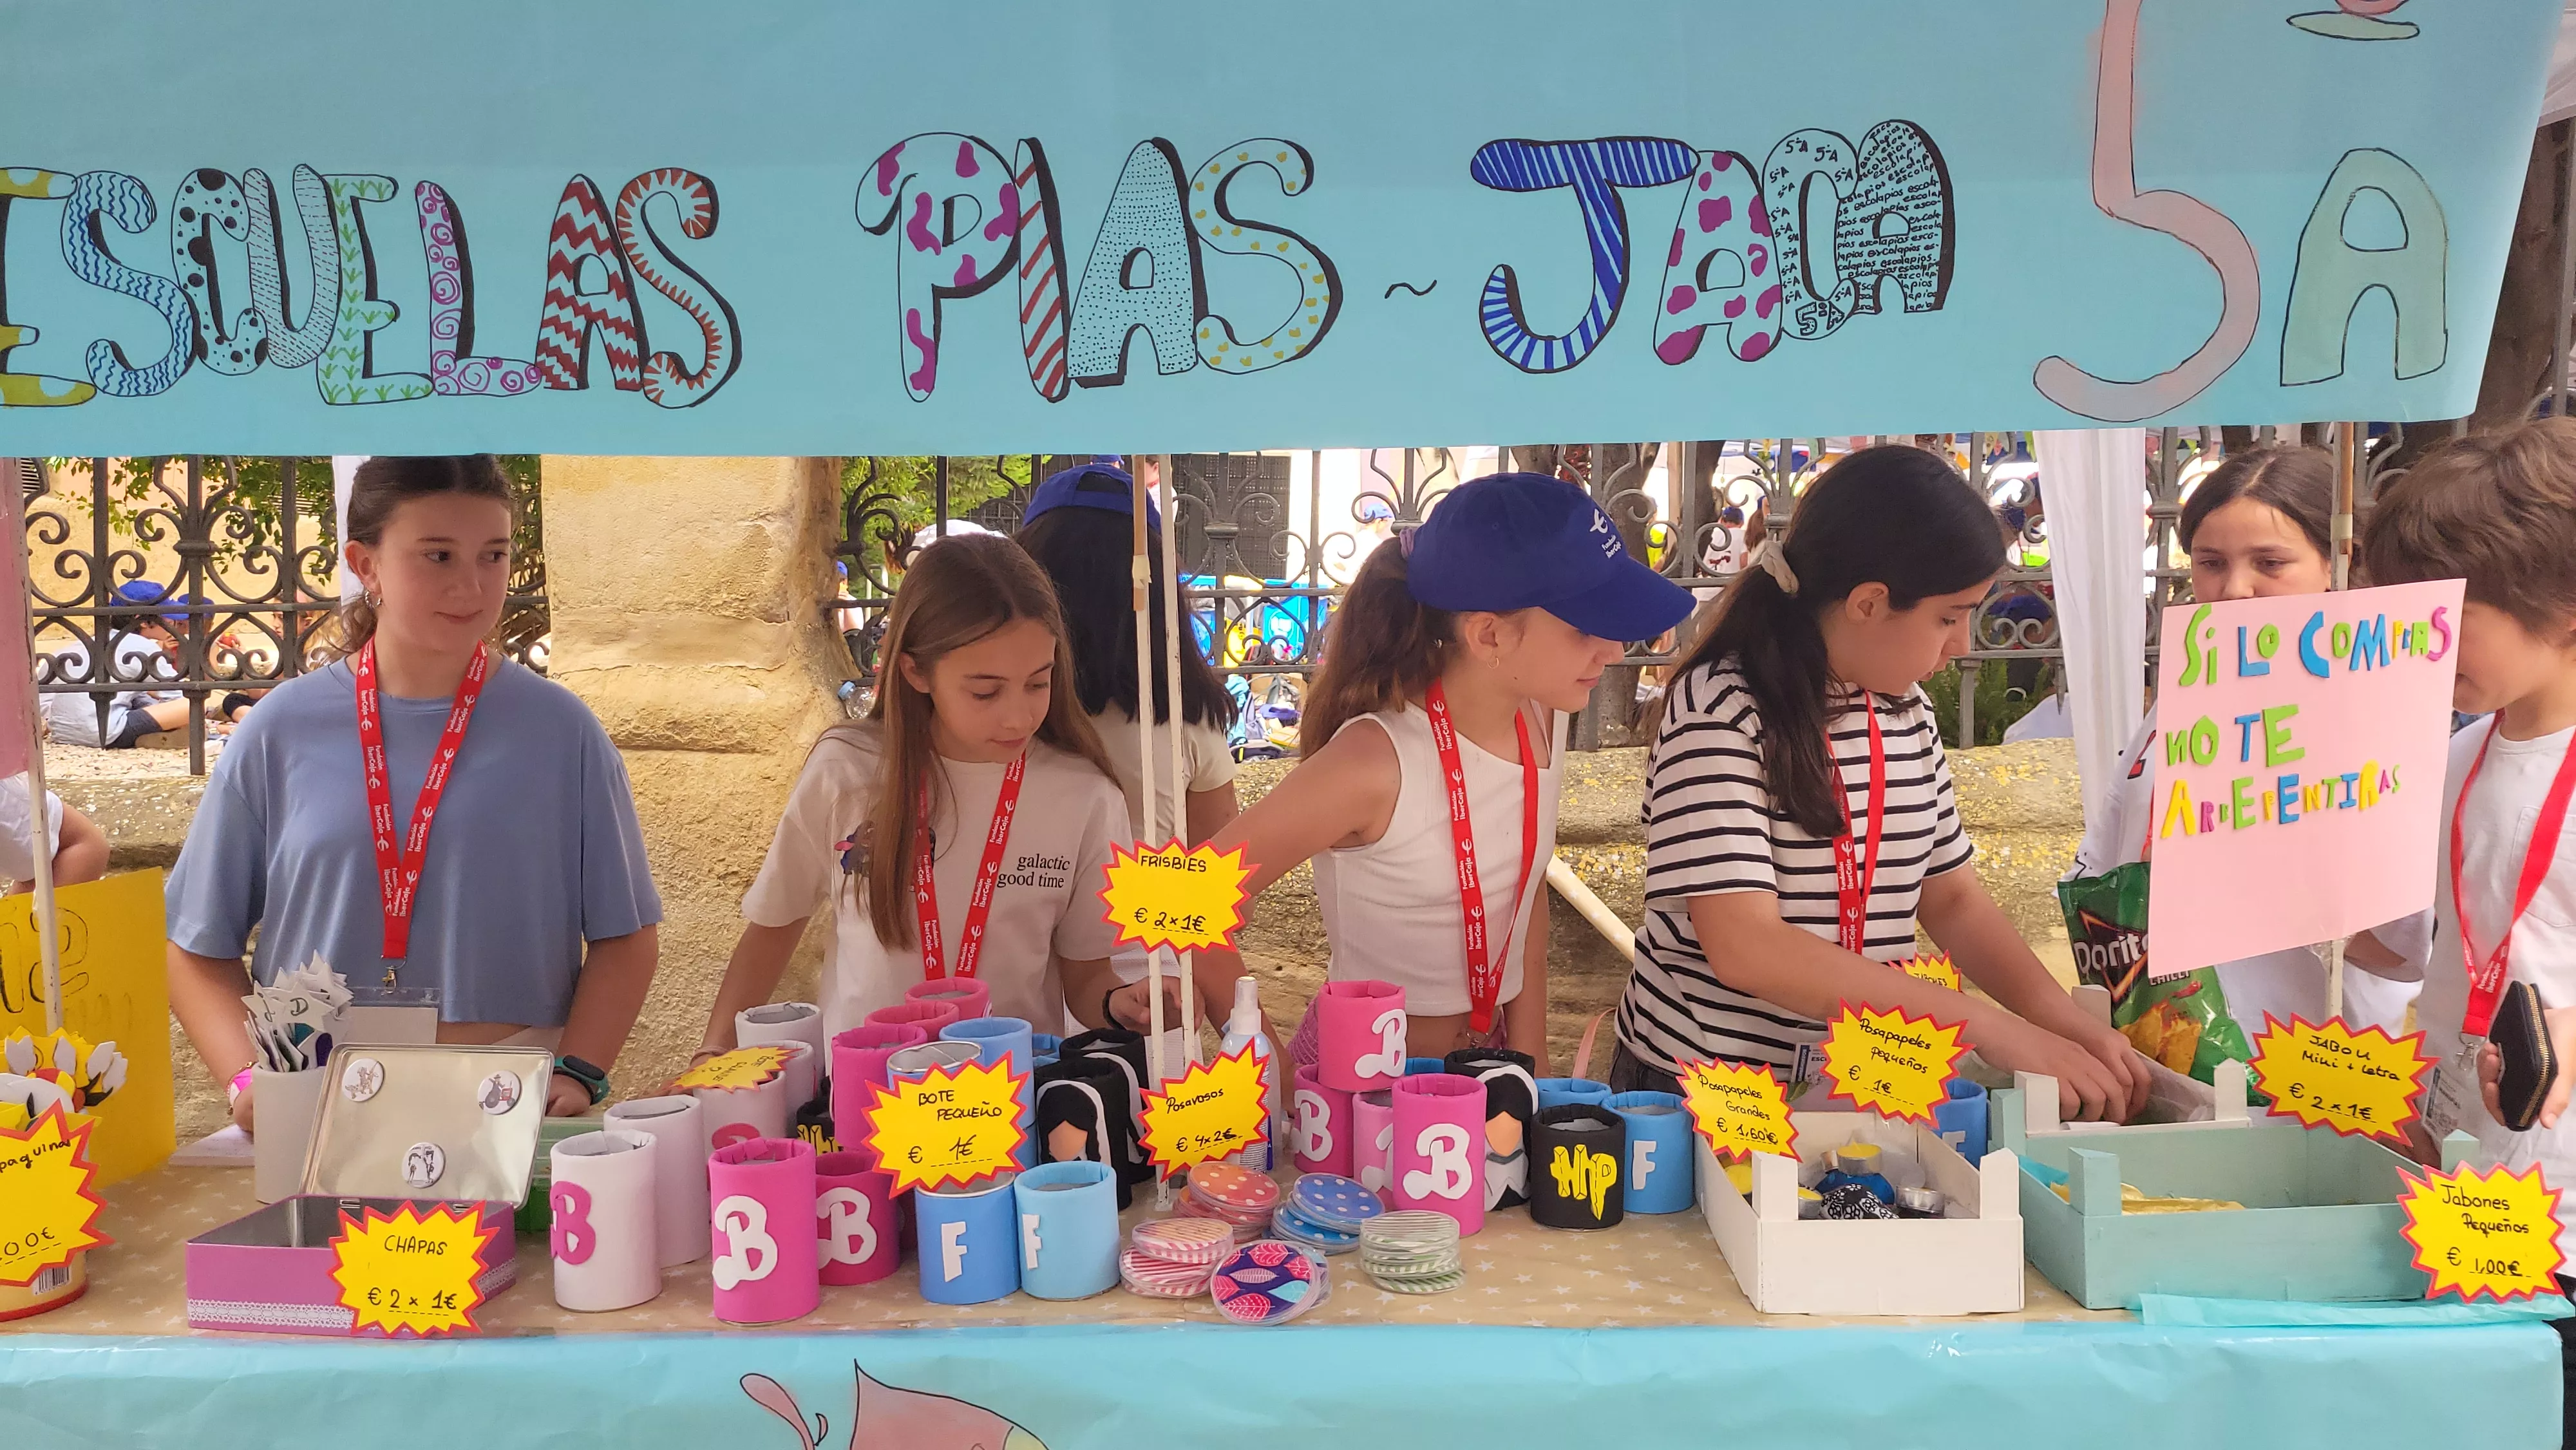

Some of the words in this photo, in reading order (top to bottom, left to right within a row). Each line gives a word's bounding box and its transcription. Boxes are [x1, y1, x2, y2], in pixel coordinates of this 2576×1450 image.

[1854, 187, 1903, 211] escolapios
[1859, 236, 1909, 248] escolapios
[855, 132, 1344, 403] PIAS
[1470, 120, 1956, 374] JACA
[2238, 623, 2280, 677] LO
[2298, 606, 2452, 679] COMPRAS
[474, 659, 484, 682] IberCaja
[455, 708, 468, 734] IberCaja
[1441, 718, 1453, 749] IberCaja
[2235, 704, 2305, 767] TE
[367, 747, 375, 773] IberCaja
[433, 762, 448, 791] IberCaja
[1457, 787, 1466, 820] IberCaja
[2161, 760, 2401, 839] ARREPENTIRAS
[375, 805, 383, 834] IberCaja
[996, 816, 1009, 845] IberCaja
[414, 822, 426, 852] IberCaja
[1017, 853, 1070, 871] galactic
[1141, 855, 1207, 872] FRISBIES
[1465, 857, 1475, 889] IberCaja
[1846, 859, 1854, 889] IberCaja
[384, 869, 393, 898] IberCaja
[980, 878, 992, 908] IberCaja
[997, 872, 1034, 889] good
[1038, 872, 1065, 889] time
[399, 887, 411, 917] IberCaja
[1134, 907, 1148, 923] €
[924, 921, 933, 951] IberCaja
[1473, 922, 1482, 950] IberCaja
[965, 942, 976, 972] IberCaja
[2074, 933, 2149, 974] Dorit
[1354, 1008, 1407, 1079] B
[1859, 1018, 1932, 1050] Posapapeles
[1698, 1073, 1763, 1099] Posapapeles
[1848, 1065, 1861, 1080] €
[1873, 1079, 1892, 1094] 1€
[2288, 1082, 2305, 1098] €
[918, 1089, 955, 1107] BOTE
[1726, 1100, 1770, 1120] Grandes
[1716, 1117, 1728, 1133] €
[907, 1145, 923, 1164] €
[1175, 1136, 1188, 1152] €
[1403, 1123, 1473, 1200] B
[1632, 1140, 1657, 1191] F
[2440, 1183, 2510, 1210] Jabones
[551, 1180, 596, 1265] B
[817, 1187, 878, 1270] B
[384, 1234, 448, 1256] CHAPAS
[712, 1194, 779, 1291] B
[941, 1221, 968, 1283] F
[1021, 1213, 1042, 1270] F
[2447, 1247, 2461, 1266] €
[368, 1287, 382, 1306] €
